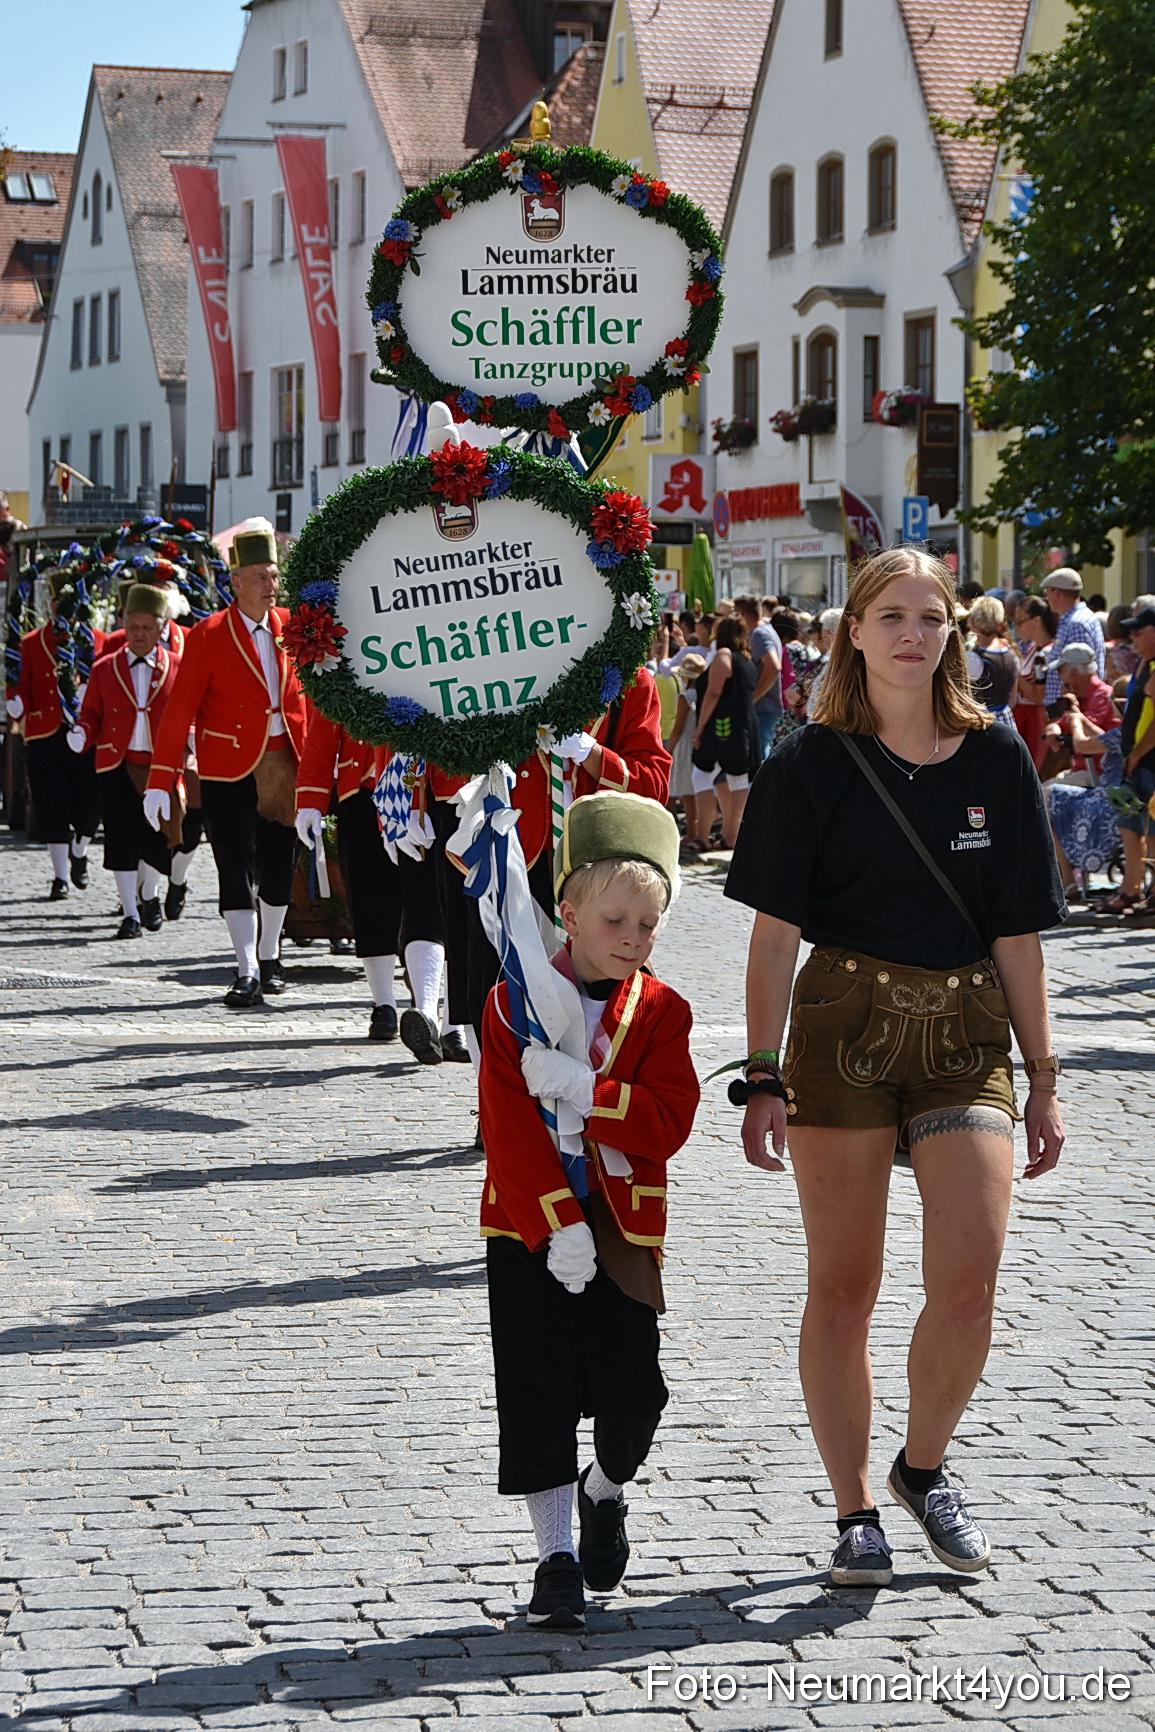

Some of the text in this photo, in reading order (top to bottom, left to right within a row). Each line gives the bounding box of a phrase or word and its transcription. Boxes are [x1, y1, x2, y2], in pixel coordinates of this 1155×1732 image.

[534, 229, 554, 238] 1628
[485, 244, 615, 265] Neumarkter
[461, 267, 639, 296] Lammsbräu
[450, 305, 643, 347] Schäffler
[449, 527, 468, 537] 1628
[908, 501, 923, 538] P
[393, 541, 533, 577] Neumarkter
[370, 561, 563, 614] Lammsbräu
[360, 610, 588, 675] Schäffler-
[429, 675, 540, 717] Tanz
